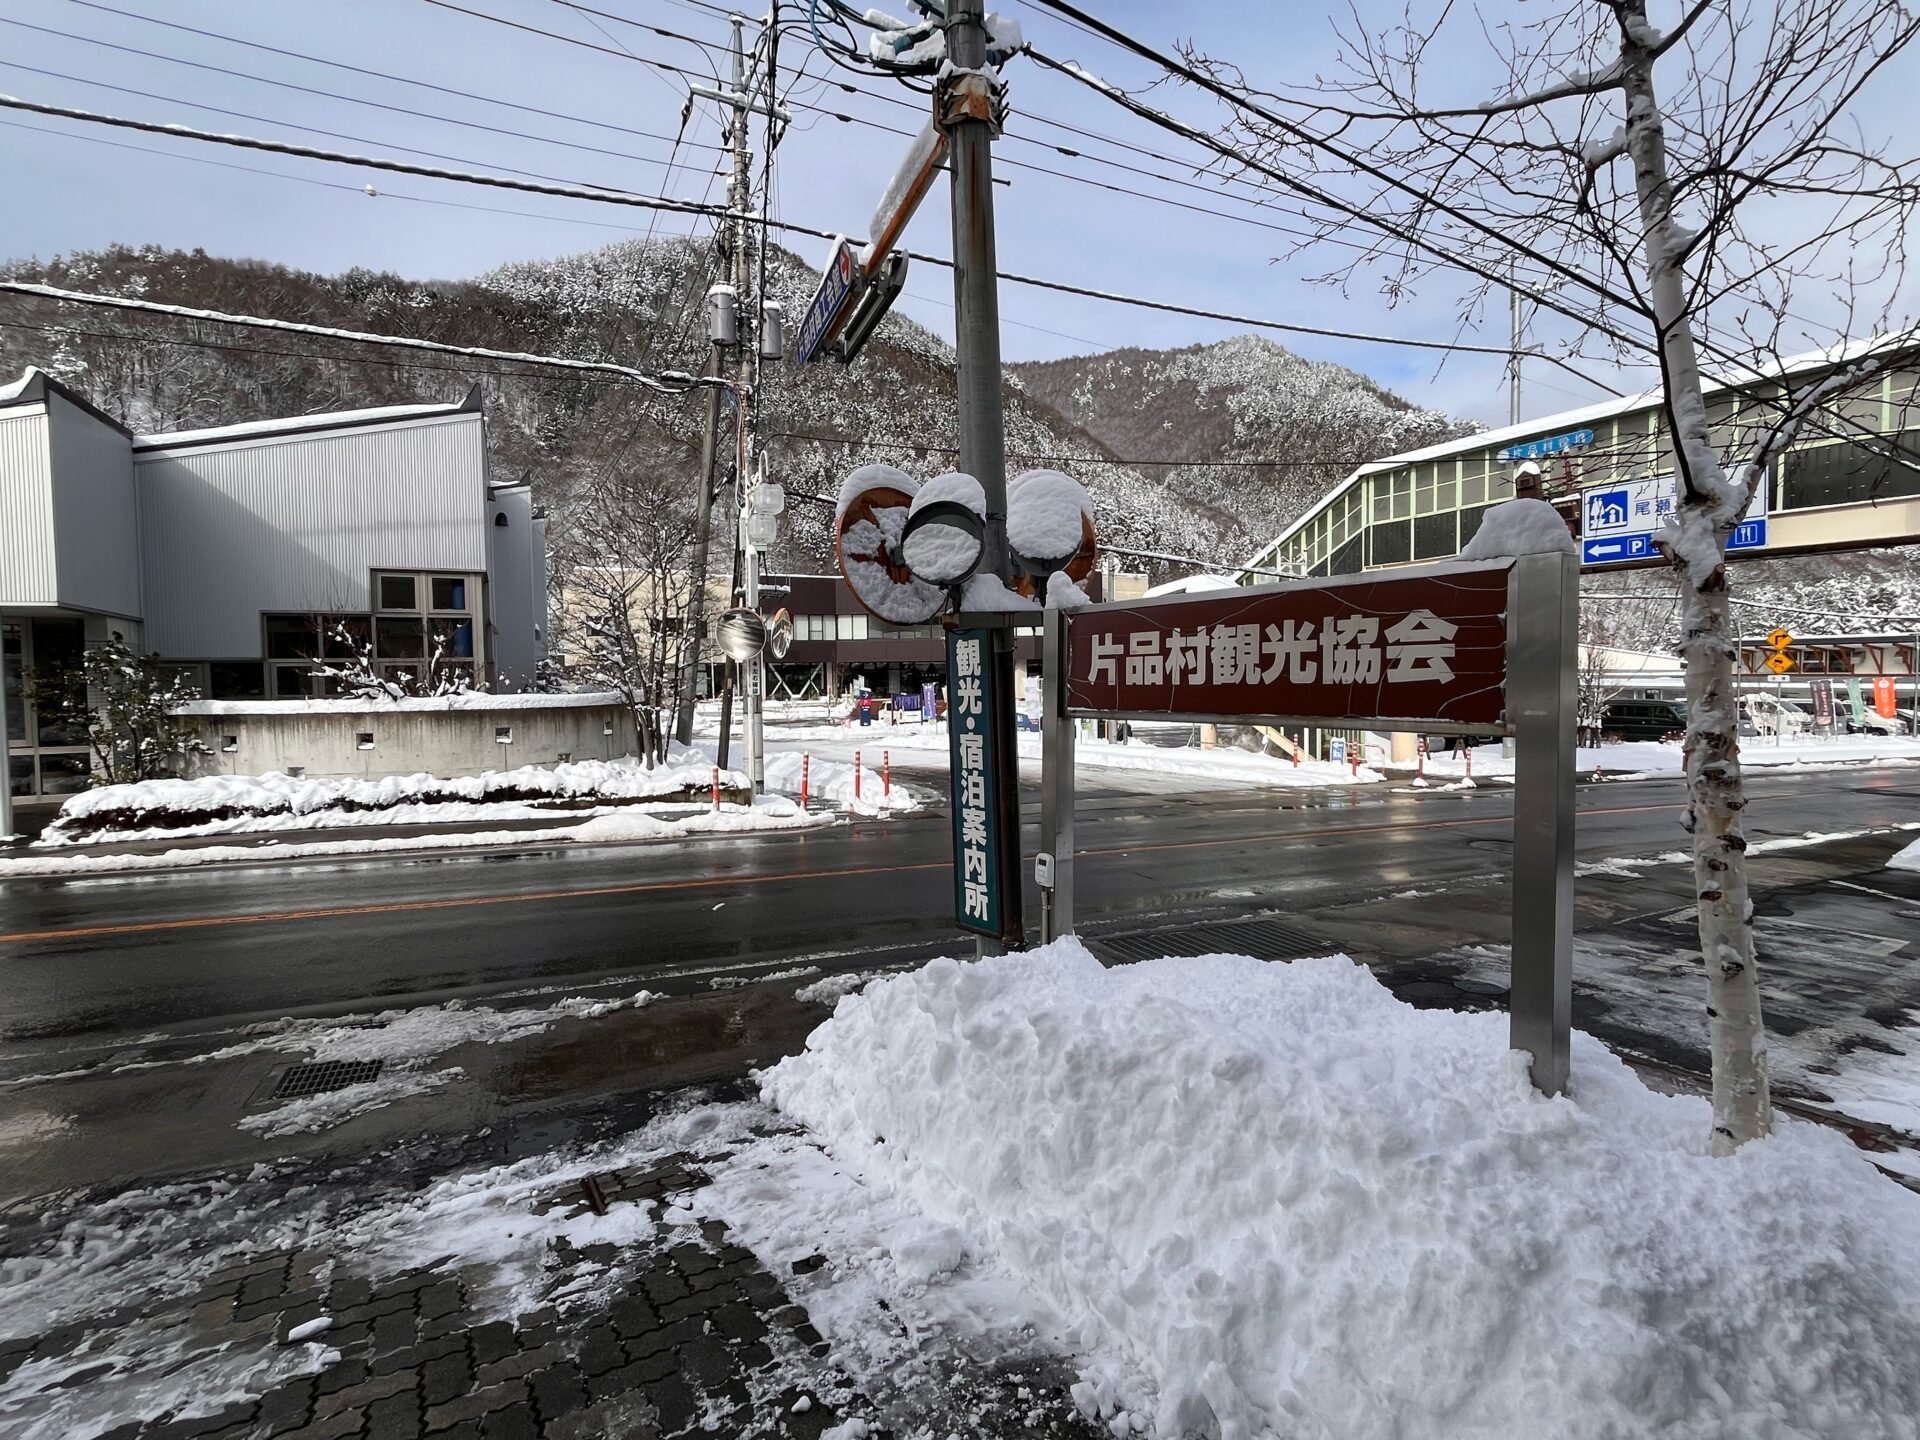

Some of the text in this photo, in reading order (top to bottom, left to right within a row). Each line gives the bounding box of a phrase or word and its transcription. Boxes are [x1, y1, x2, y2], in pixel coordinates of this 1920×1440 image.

[1088, 608, 1459, 685] 片品村観光協会
[956, 639, 989, 921] 観光・宿泊案内所
